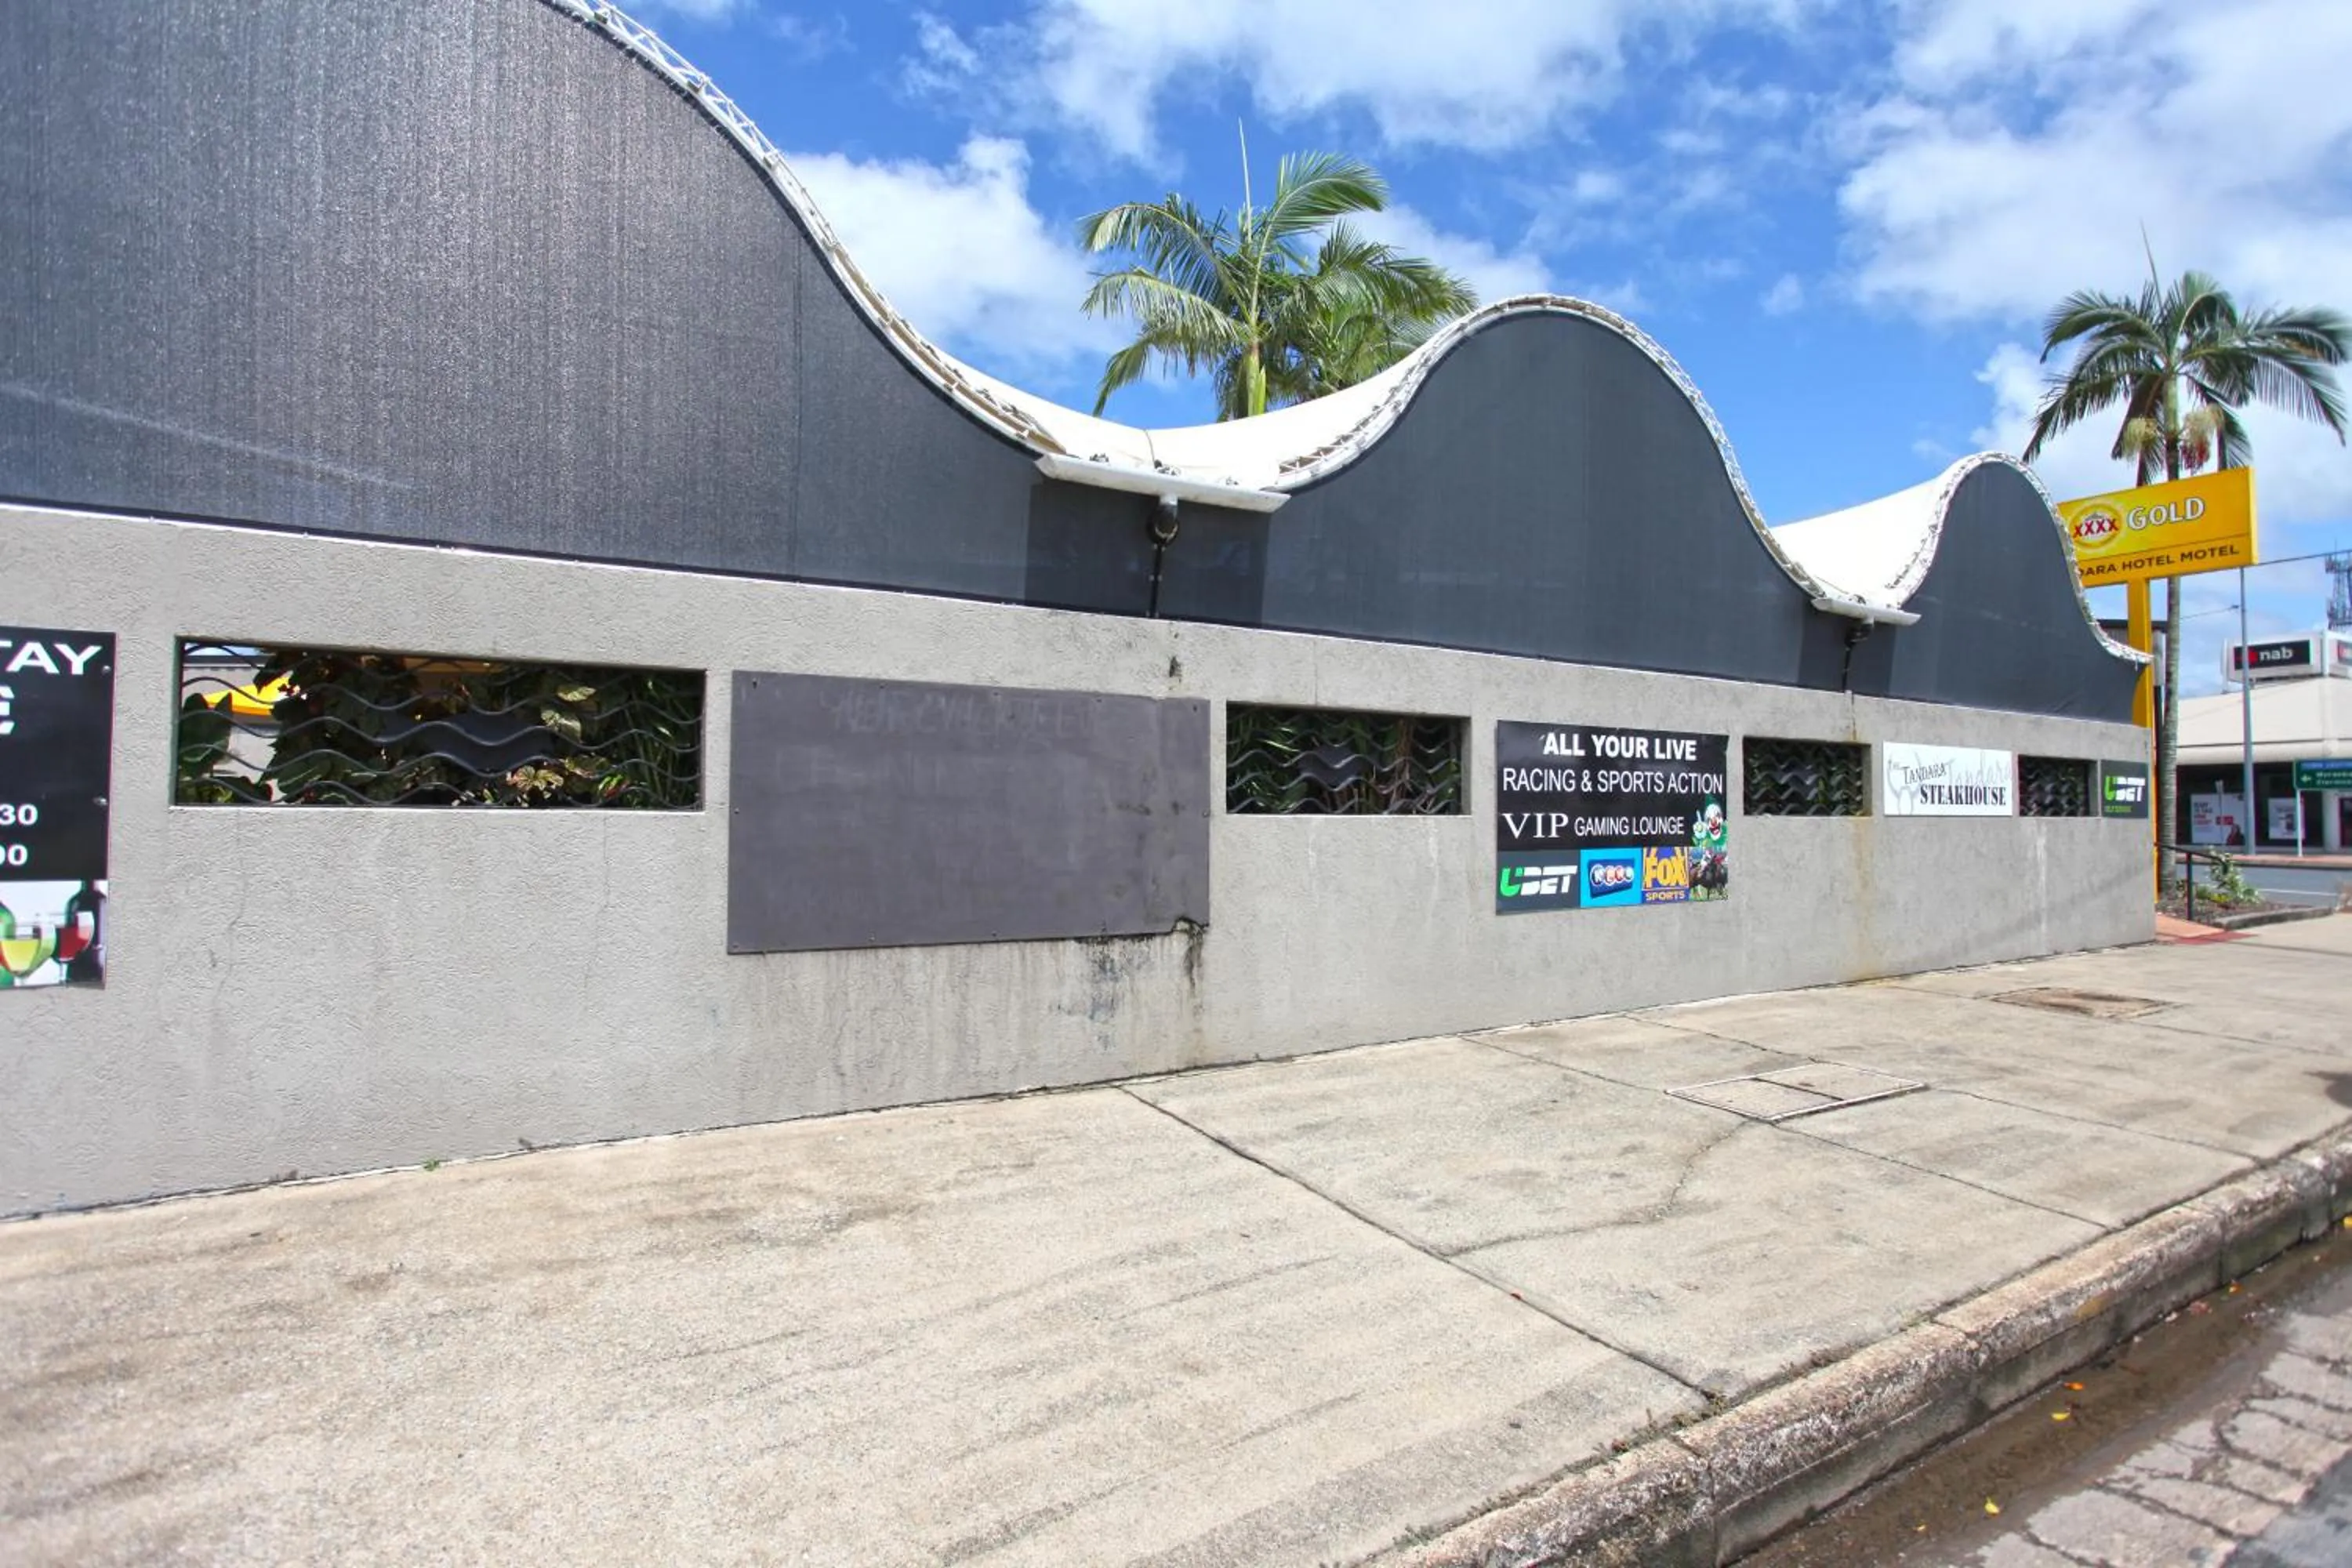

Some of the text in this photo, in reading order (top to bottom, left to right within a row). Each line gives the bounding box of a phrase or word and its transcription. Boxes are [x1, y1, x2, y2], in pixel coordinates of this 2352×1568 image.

[2073, 497, 2205, 539] XXXX GOLD
[2122, 554, 2176, 572] HOTEL
[2180, 545, 2240, 562] MOTEL
[2259, 647, 2293, 663] nab
[1543, 732, 1697, 760] ALL YOUR LIVE
[1503, 768, 1723, 794] RACING & SPORTS ACTION
[2105, 776, 2146, 802] UBET
[1921, 784, 2006, 806] STEAKHOUSE
[1502, 812, 1684, 840] VIP GAMING LOUNGE
[1500, 866, 1578, 898] UBET
[1645, 856, 1686, 888] FOX
[1646, 891, 1686, 901] SPORTS
